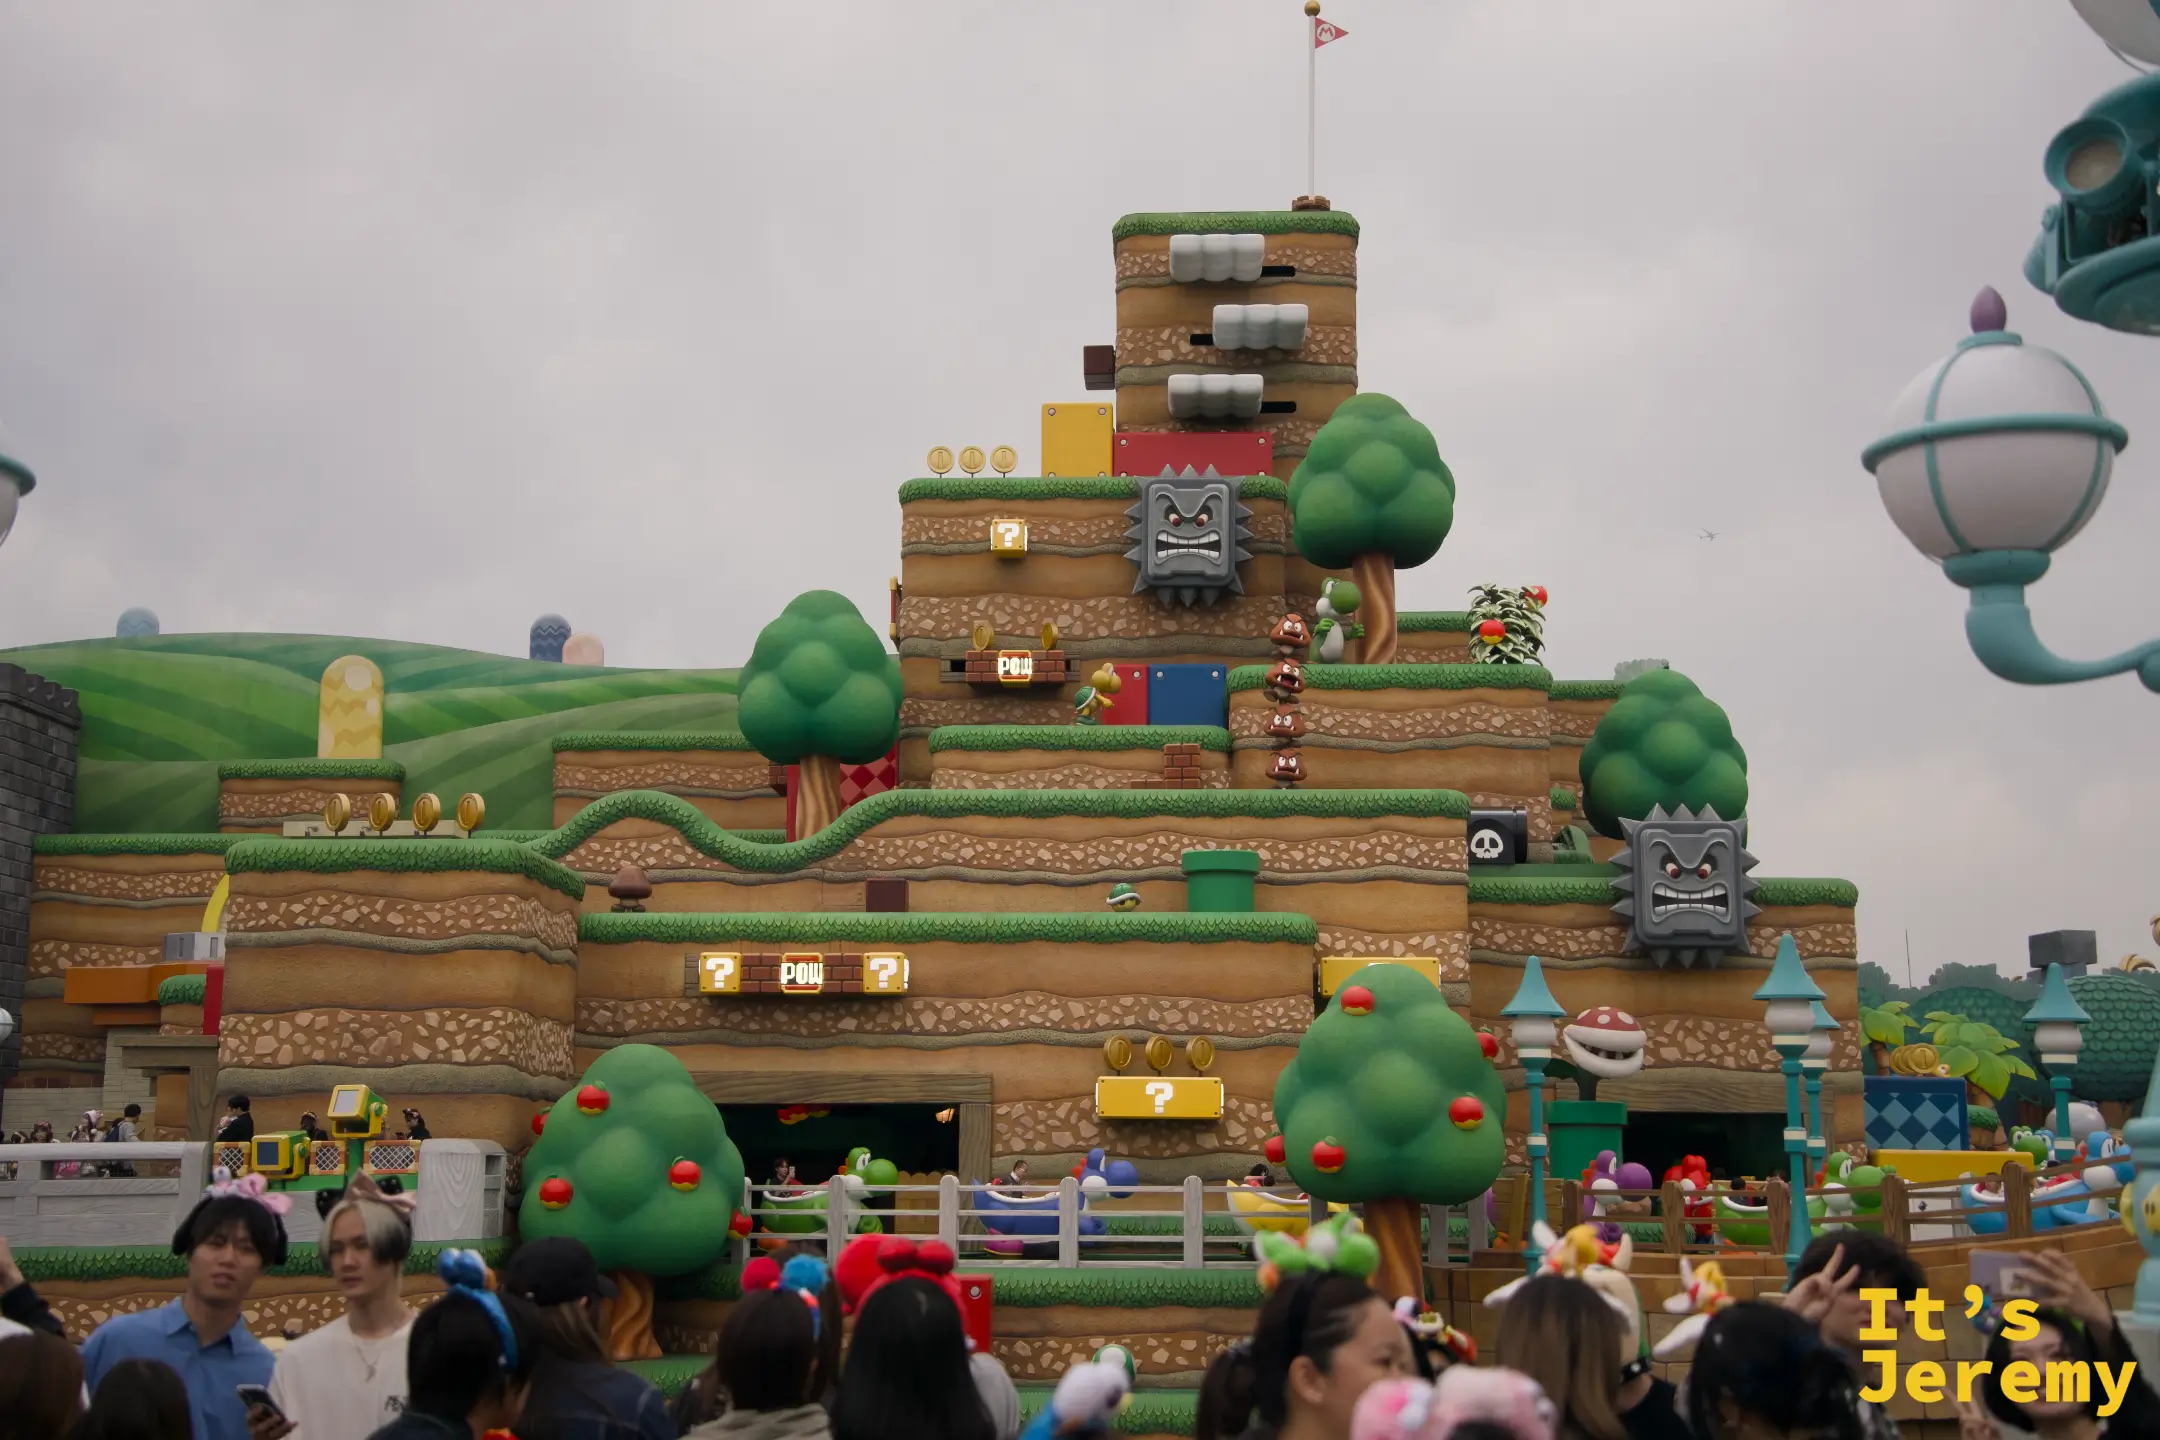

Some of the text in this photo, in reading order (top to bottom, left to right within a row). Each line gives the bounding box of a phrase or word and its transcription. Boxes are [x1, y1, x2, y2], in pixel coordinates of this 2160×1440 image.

[1318, 26, 1334, 37] M
[997, 522, 1020, 548] ?
[997, 656, 1033, 675] POW
[705, 957, 898, 989] ? POW ?
[1145, 1082, 1174, 1114] ?
